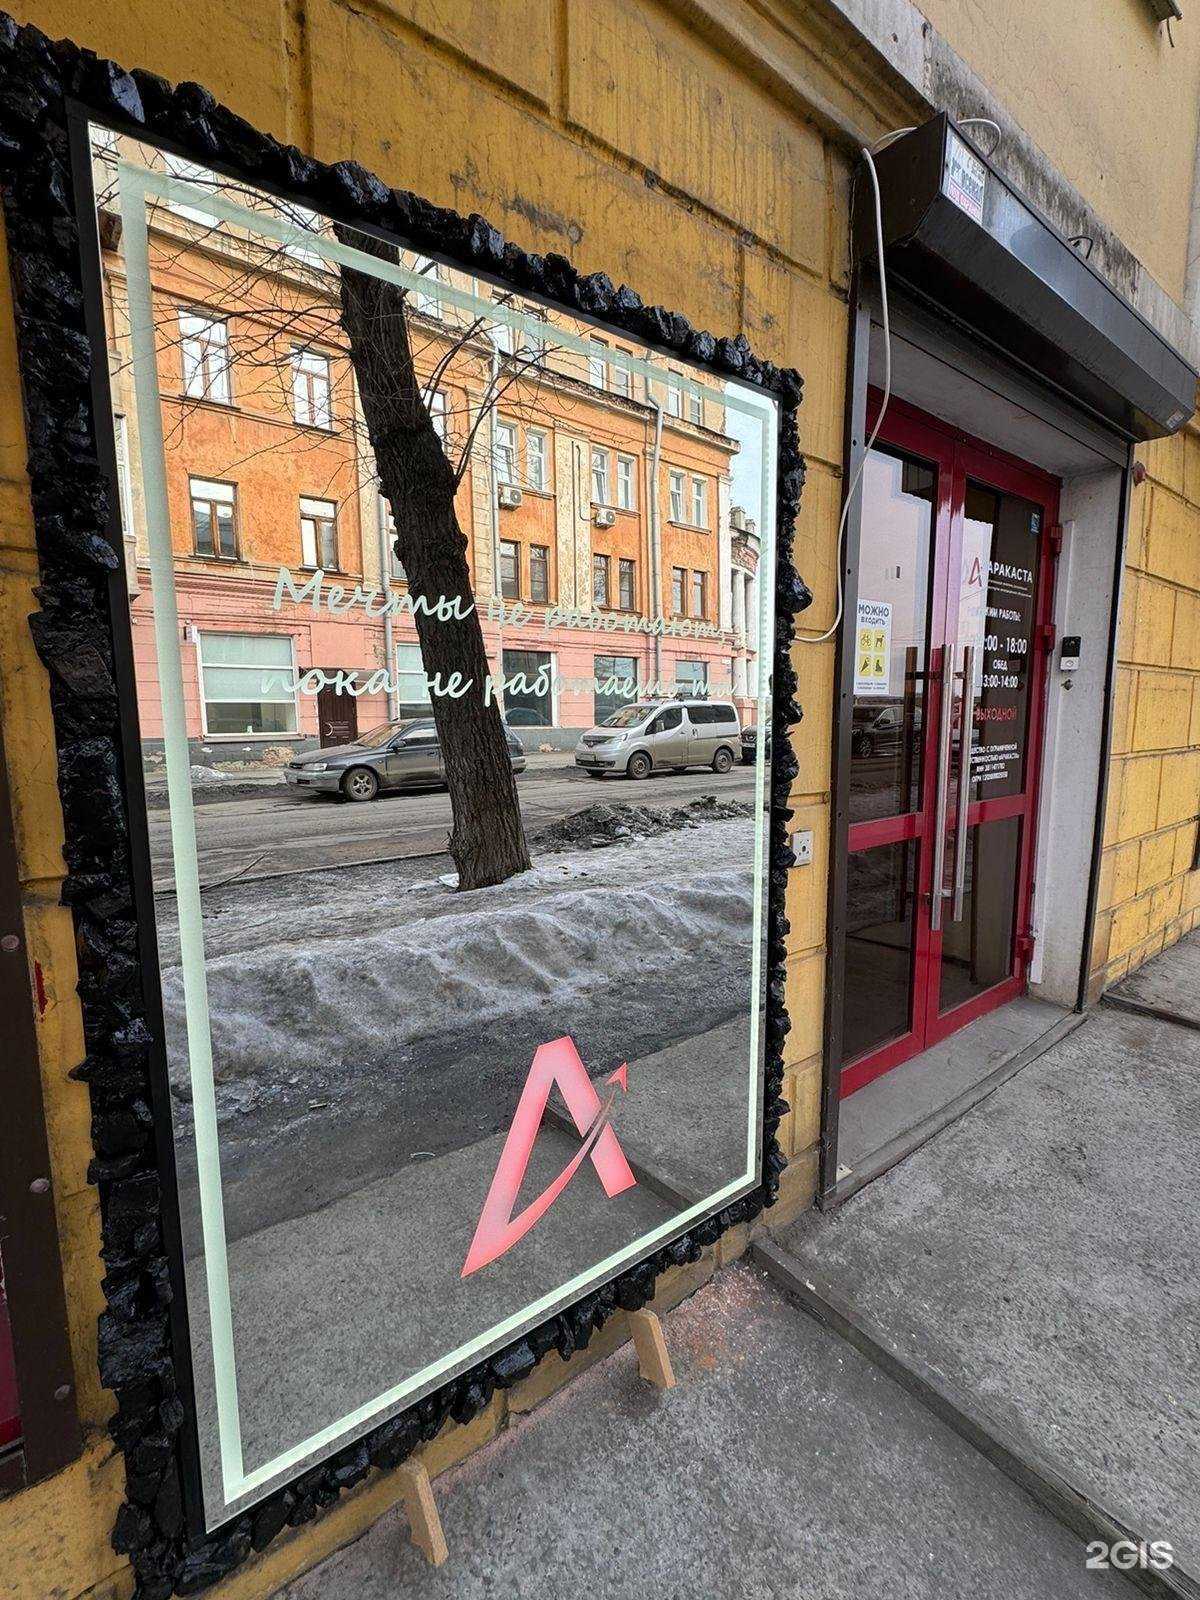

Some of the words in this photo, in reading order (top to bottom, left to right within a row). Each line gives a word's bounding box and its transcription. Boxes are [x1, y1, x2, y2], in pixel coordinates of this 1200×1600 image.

[272, 566, 475, 622] Мечты
[486, 595, 535, 629] не
[858, 603, 890, 617] МОЖНО
[1007, 637, 1028, 655] 18:00
[993, 659, 1008, 671] ОБЕД
[260, 667, 398, 697] пока
[421, 670, 475, 699] не
[975, 704, 1017, 721] ВЫХОДНОЙ
